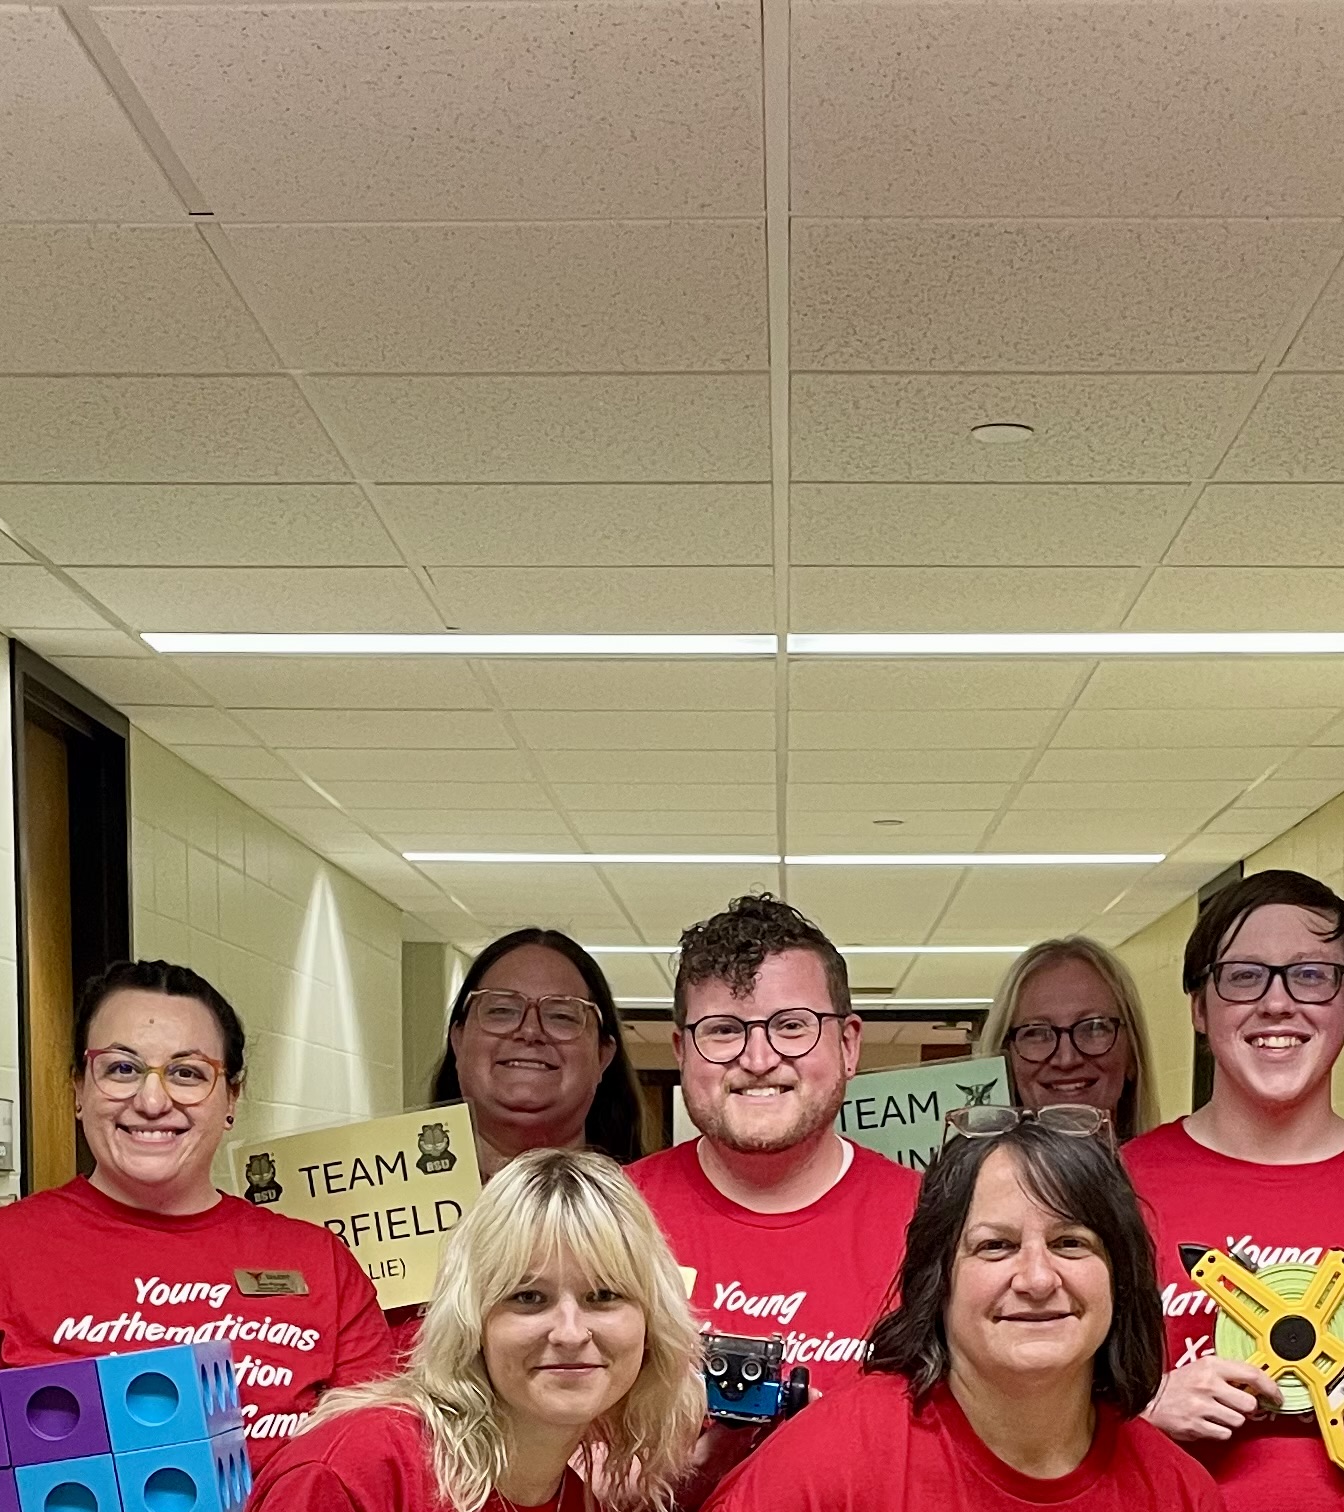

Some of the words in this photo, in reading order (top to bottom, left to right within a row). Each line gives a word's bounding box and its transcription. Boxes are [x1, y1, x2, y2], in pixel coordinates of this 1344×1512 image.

[840, 1090, 940, 1132] TEAM
[298, 1150, 409, 1198] TEAM
[324, 1199, 463, 1248] RFIELD
[134, 1276, 231, 1308] Young
[713, 1281, 807, 1324] Young
[53, 1311, 320, 1352] Mathematicians
